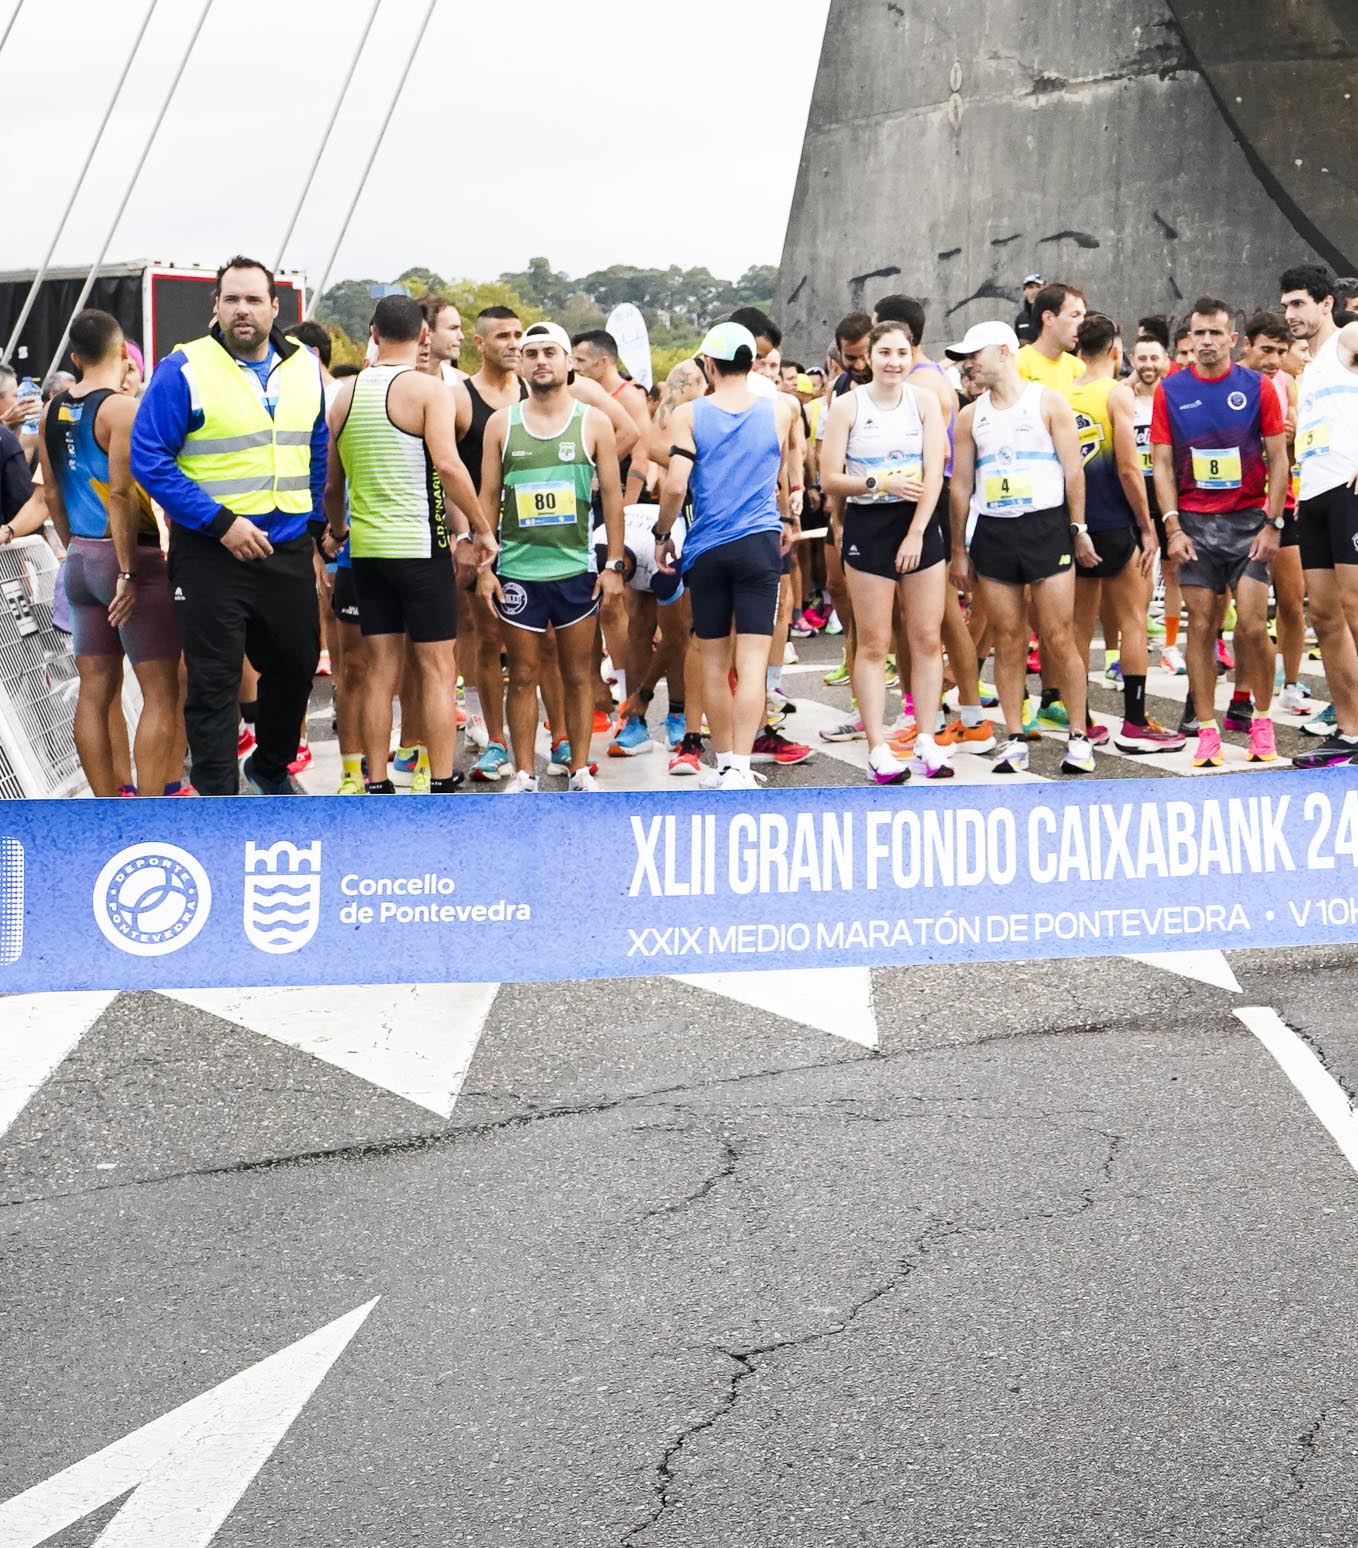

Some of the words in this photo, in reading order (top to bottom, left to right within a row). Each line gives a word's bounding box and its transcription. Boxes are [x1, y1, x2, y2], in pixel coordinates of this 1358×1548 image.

[1210, 459, 1219, 475] 8
[1001, 478, 1010, 493] 4
[534, 492, 556, 511] 80
[627, 814, 718, 897] XLII
[726, 810, 855, 895] GRAN
[866, 806, 1017, 890] FONDO
[1026, 794, 1297, 882] CAIXABANK
[115, 859, 190, 883] DEPORTE
[340, 873, 456, 897] Concello
[108, 901, 196, 942] PONTEVEDRA
[339, 901, 375, 925] de
[379, 897, 532, 924] Pontevedra
[627, 926, 702, 958] XXIX
[709, 923, 811, 956] MEDIO
[816, 911, 982, 951] MARATÓN
[986, 914, 1029, 943] DE
[1034, 903, 1251, 942] PONTEVEDRA
